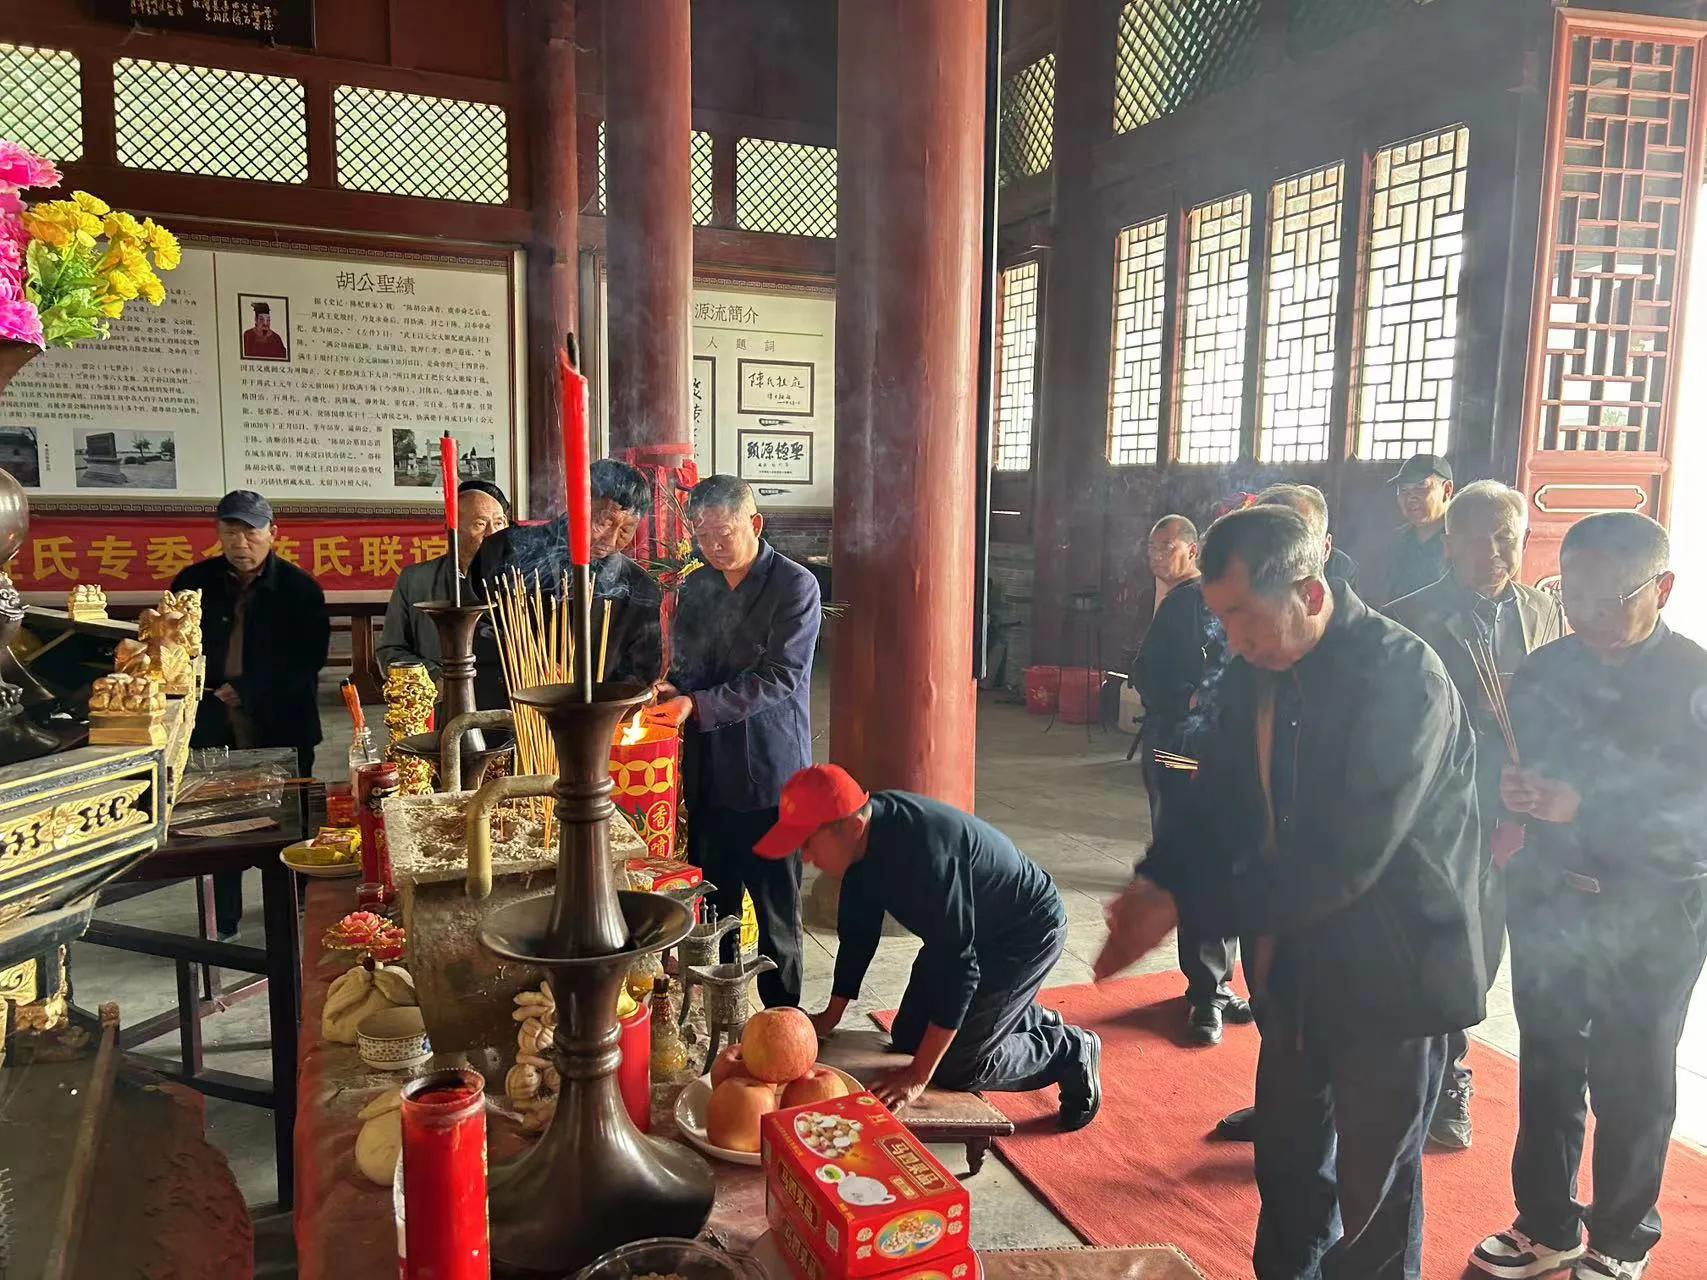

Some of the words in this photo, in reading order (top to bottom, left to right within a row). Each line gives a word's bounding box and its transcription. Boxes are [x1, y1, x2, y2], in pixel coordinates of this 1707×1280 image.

[336, 271, 416, 296] 胡公聖績
[694, 302, 760, 325] 源流簡介
